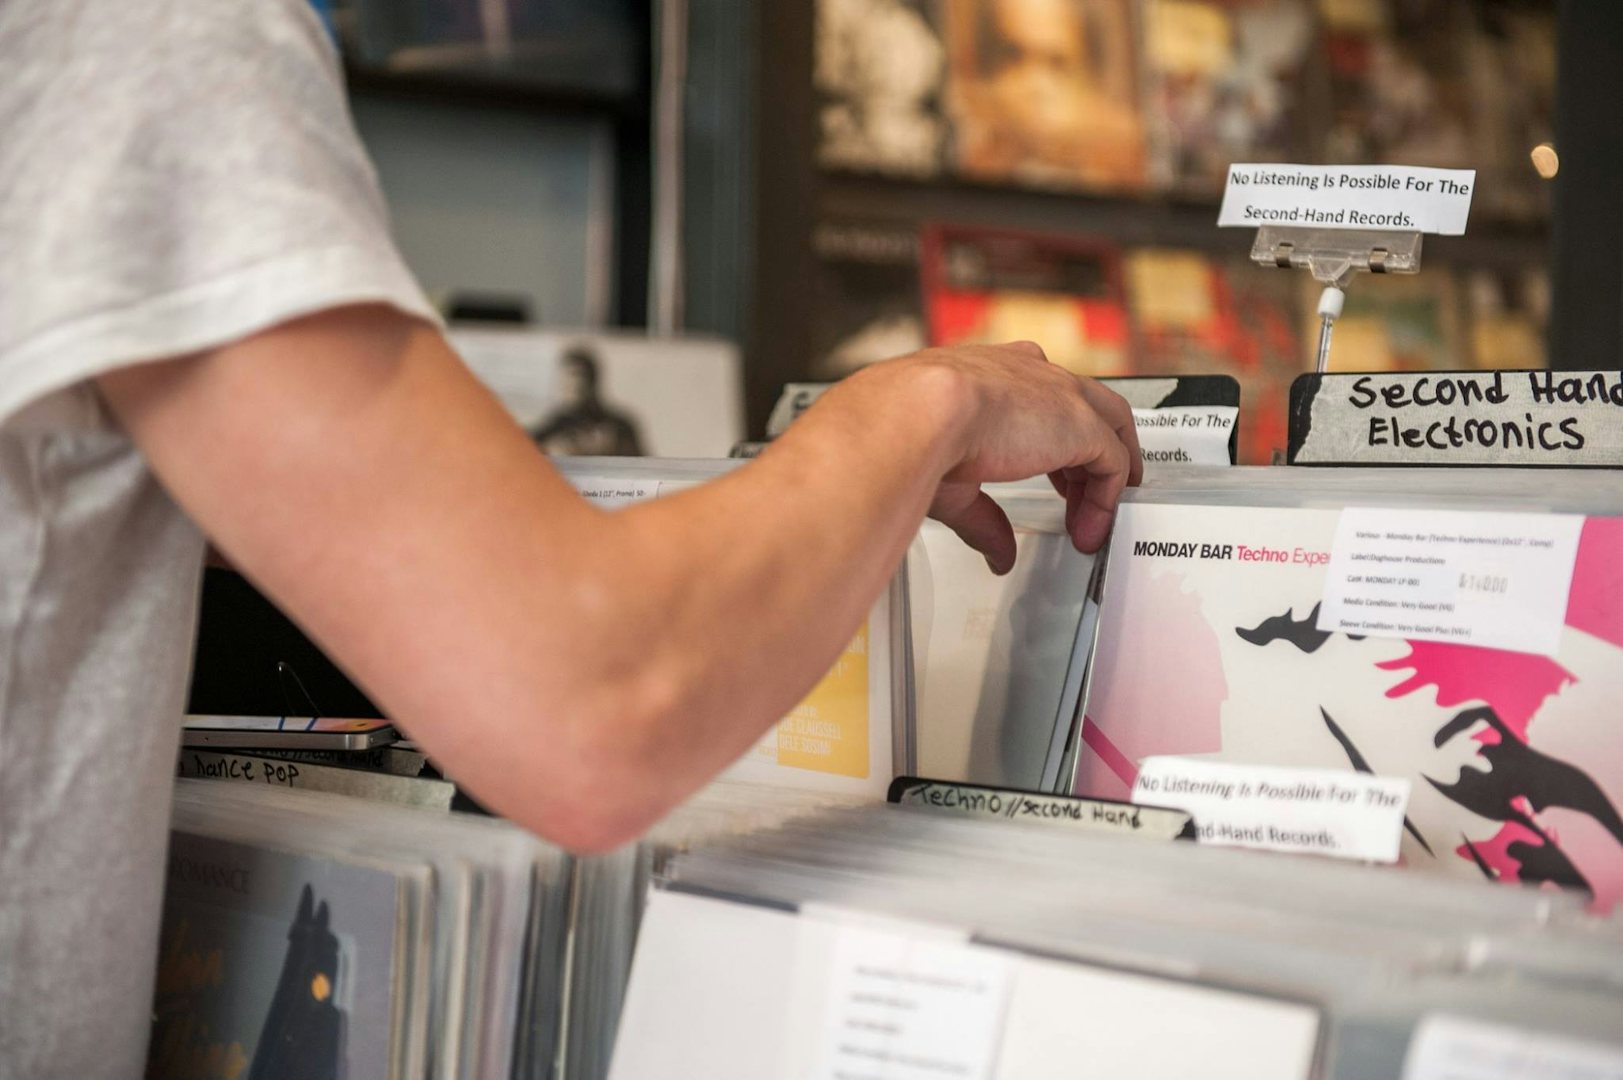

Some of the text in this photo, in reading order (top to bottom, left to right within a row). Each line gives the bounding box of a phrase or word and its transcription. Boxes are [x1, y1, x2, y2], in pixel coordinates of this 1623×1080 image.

[1230, 171, 1470, 196] No Listening Is Possible For The
[1243, 205, 1415, 227] Second-Hand Records.
[1349, 370, 1509, 409] Second
[1135, 413, 1232, 428] ossible For The
[1368, 412, 1585, 450] Electronics
[1386, 533, 1413, 543] Monday
[1133, 541, 1198, 558] MONDAY
[1200, 545, 1233, 560] BAR
[1237, 545, 1289, 563] Techno
[1405, 556, 1446, 565] Productions
[1365, 576, 1396, 585] MONDAY
[1343, 597, 1364, 607] Media
[1365, 599, 1398, 608] Condition:
[1401, 601, 1417, 610] Very
[1418, 601, 1437, 611] Good
[1339, 619, 1360, 628] Sleeve
[1362, 620, 1395, 630] Condition:
[1398, 623, 1414, 633] Very
[1415, 624, 1434, 633] Good
[1138, 775, 1401, 808] No Listening Is Possible For The
[1269, 824, 1341, 849] Records.
